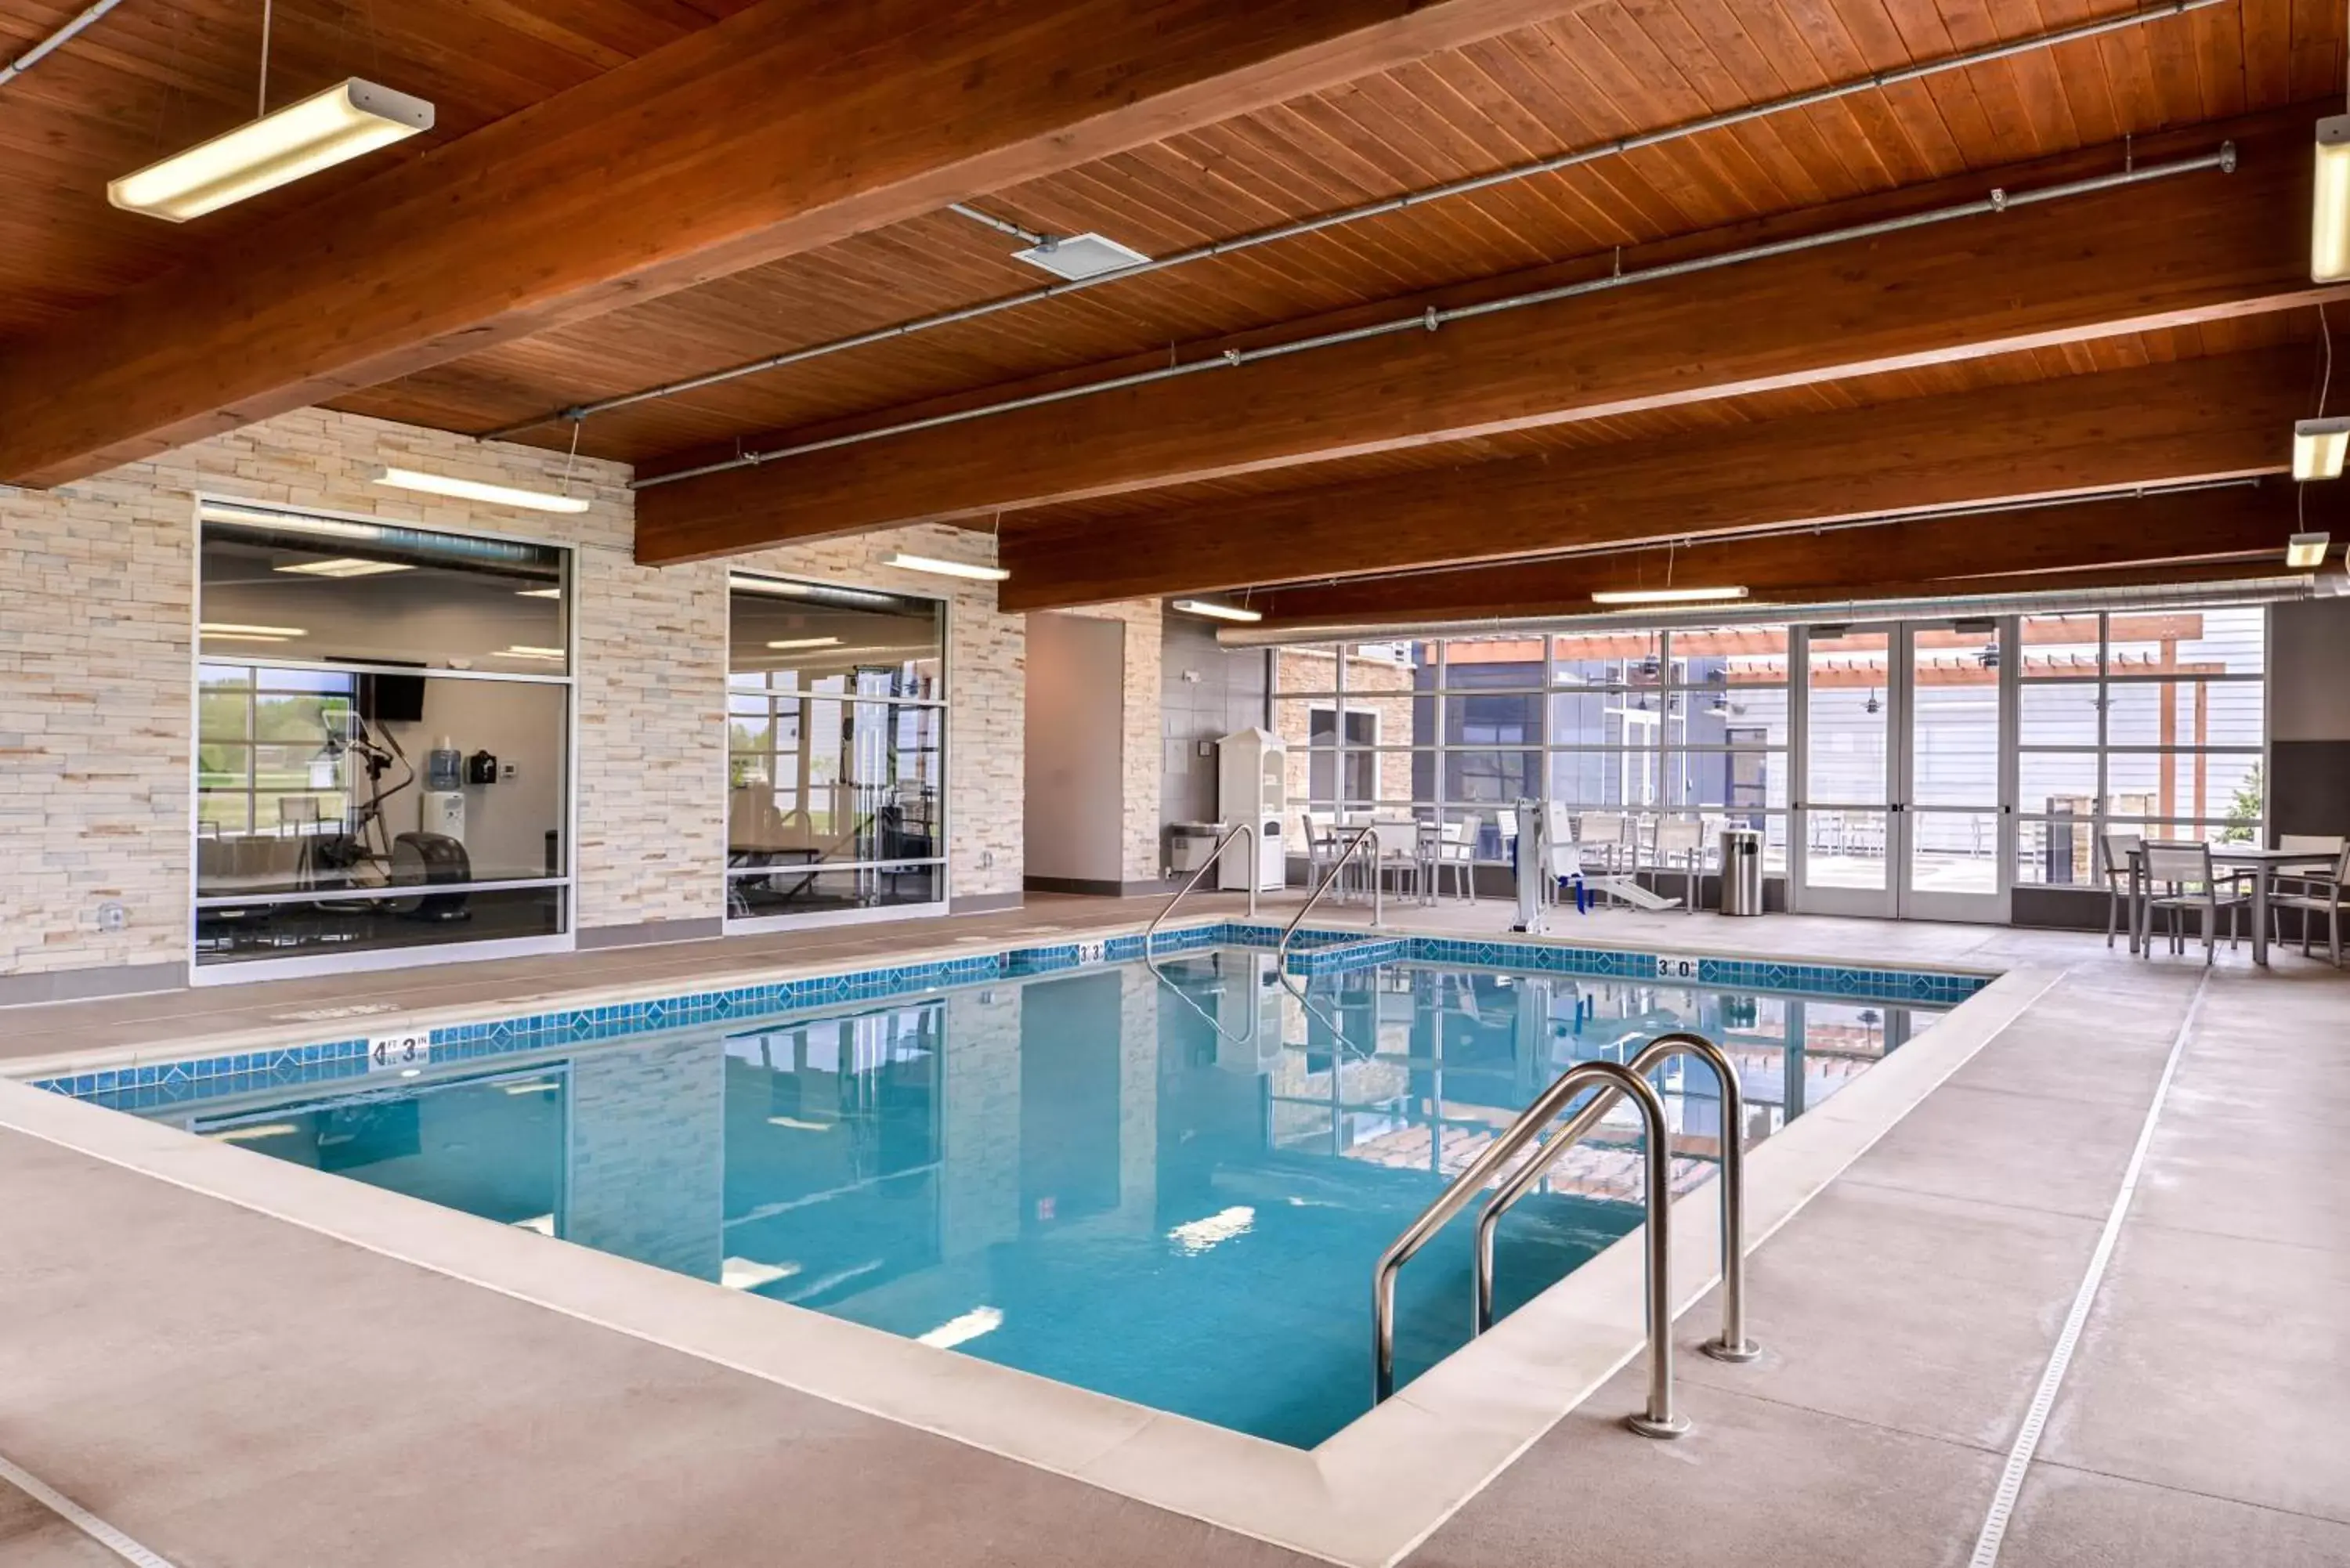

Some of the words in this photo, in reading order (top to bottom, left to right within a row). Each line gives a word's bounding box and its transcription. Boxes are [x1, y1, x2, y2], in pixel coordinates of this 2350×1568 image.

[1658, 959, 1668, 976] 3
[1679, 961, 1690, 977] 0
[402, 1038, 416, 1061] 3
